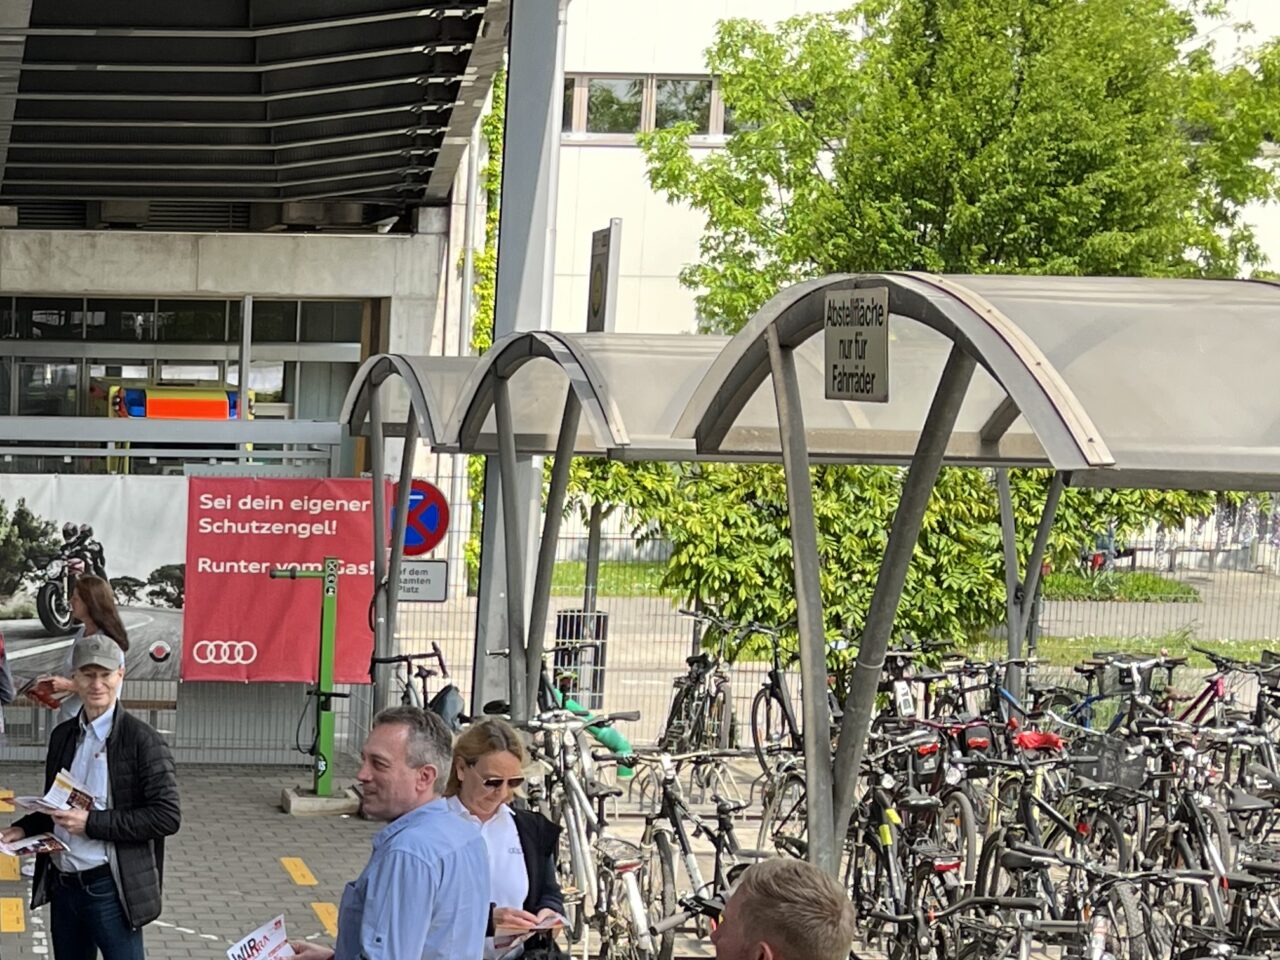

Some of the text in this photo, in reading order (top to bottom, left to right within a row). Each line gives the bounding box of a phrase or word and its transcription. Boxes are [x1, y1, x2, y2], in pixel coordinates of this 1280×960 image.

[826, 297, 884, 327] Abstellfläche
[839, 331, 868, 360] nur für
[832, 364, 876, 394] Fahrräder
[199, 494, 371, 515] Sei dein eigener
[198, 518, 337, 538] Schutzengel!
[197, 557, 270, 573] Runter
[408, 568, 428, 576] dem
